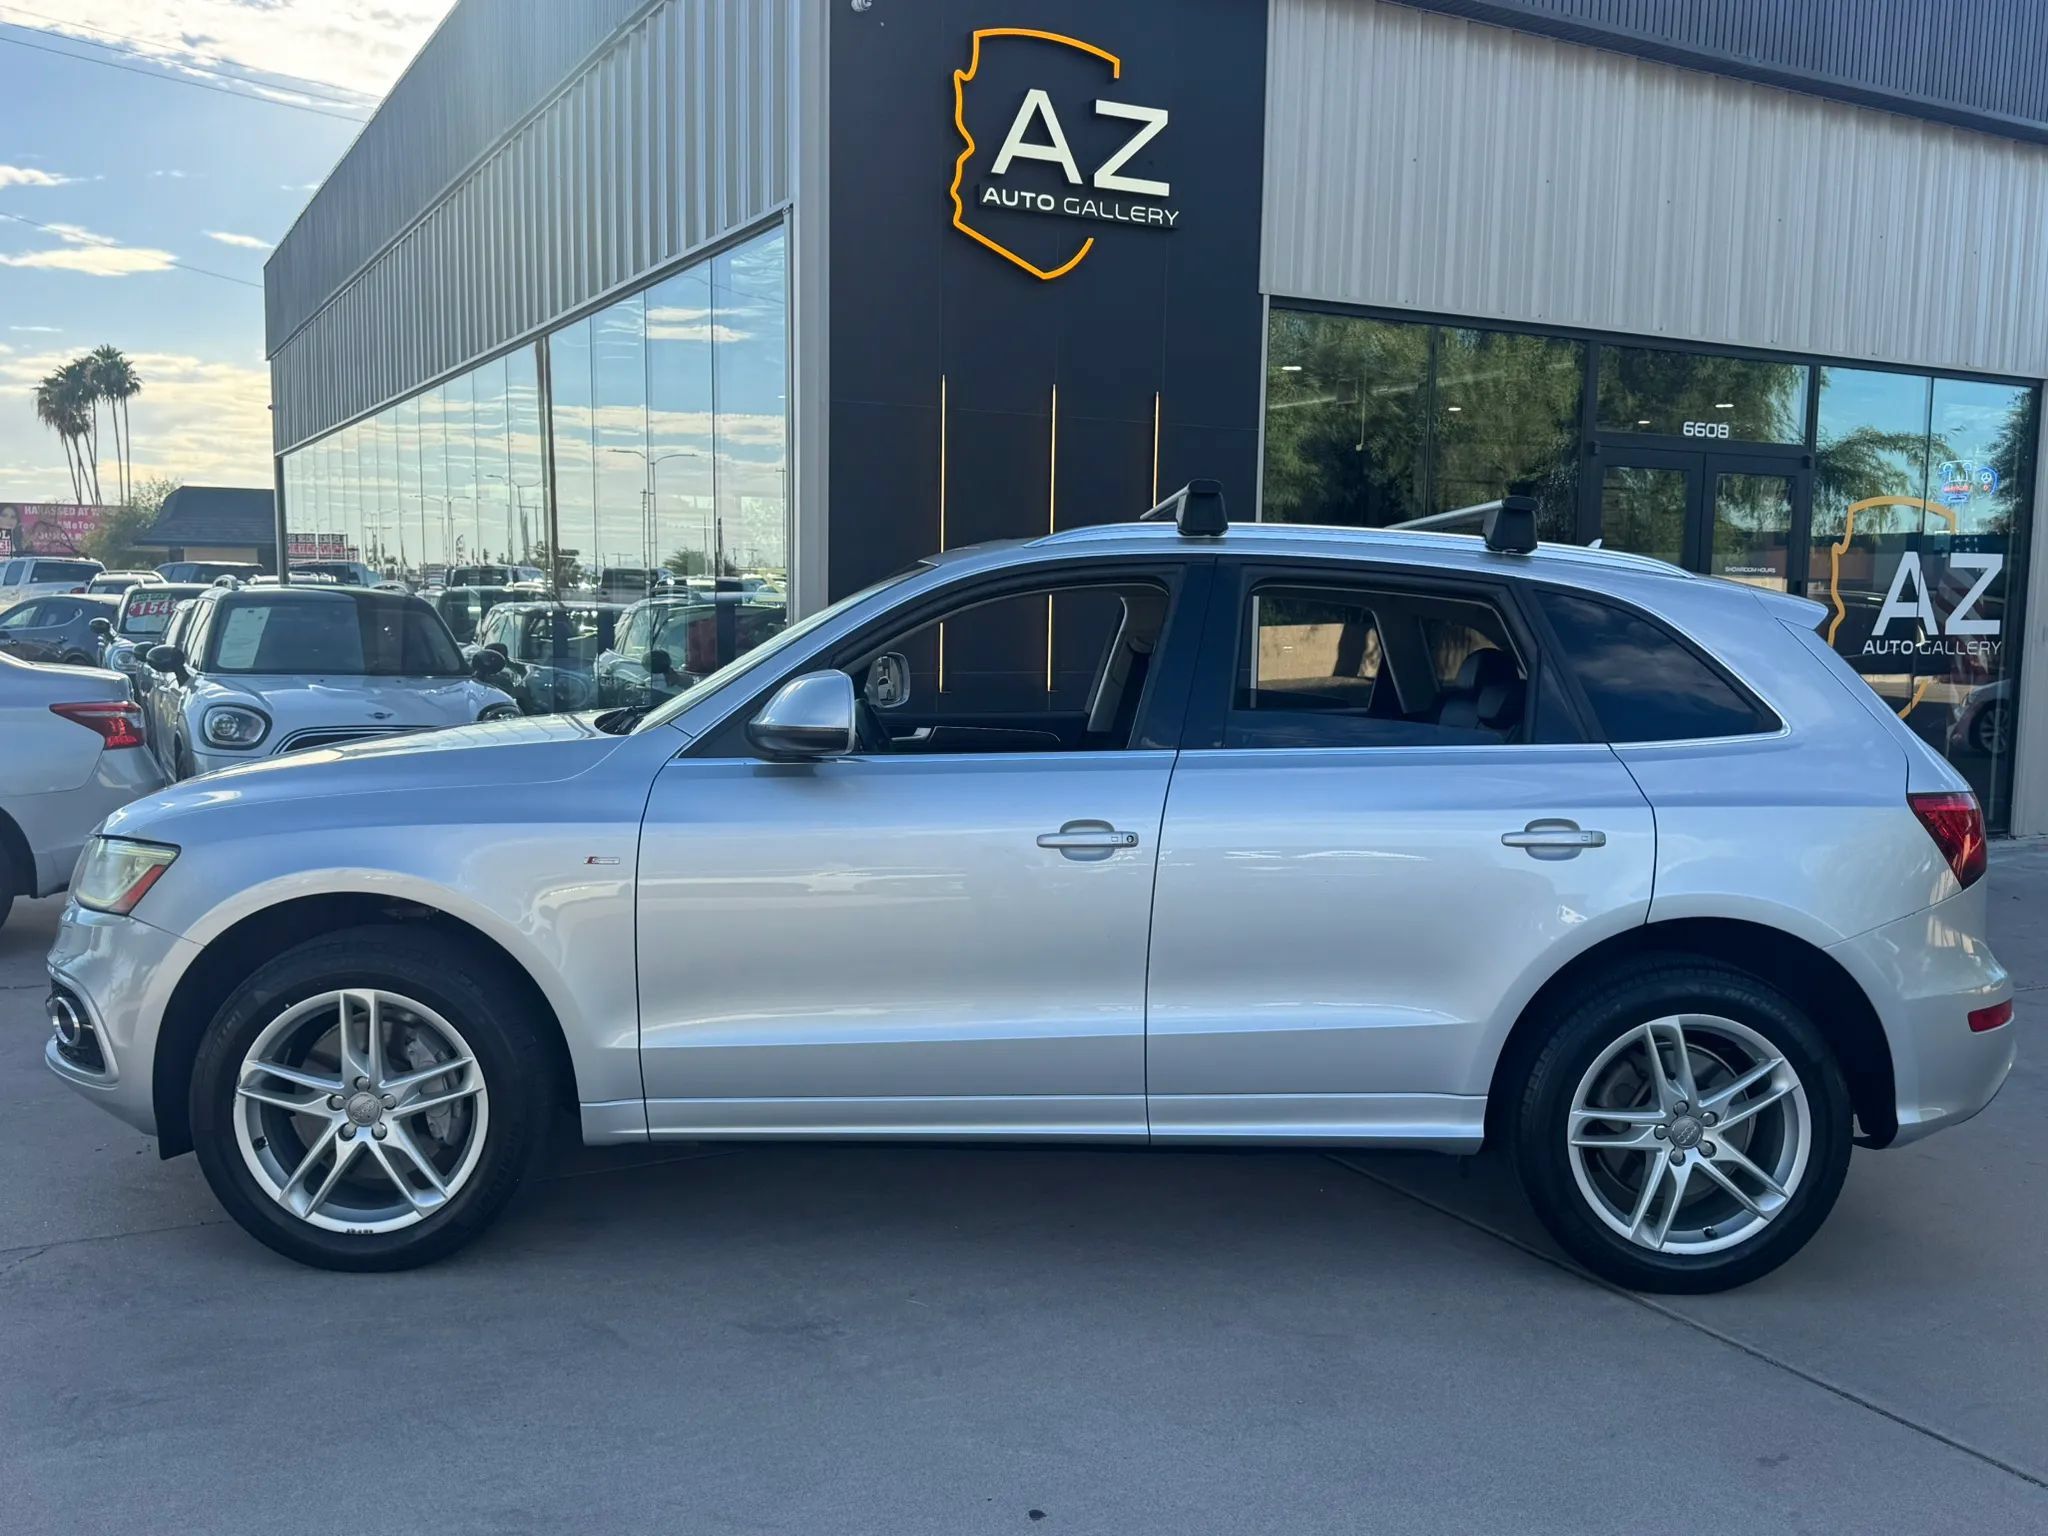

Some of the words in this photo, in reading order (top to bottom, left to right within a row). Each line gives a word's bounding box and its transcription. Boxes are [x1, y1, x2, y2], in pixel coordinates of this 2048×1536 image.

[991, 89, 1170, 197] AZ
[982, 186, 1055, 211] AUTO
[1063, 197, 1180, 226] GALLERY
[1683, 421, 1730, 439] 6608
[1871, 551, 2004, 636] AZ
[1862, 640, 1914, 655] AUTO
[1918, 640, 2002, 655] GALLERY
